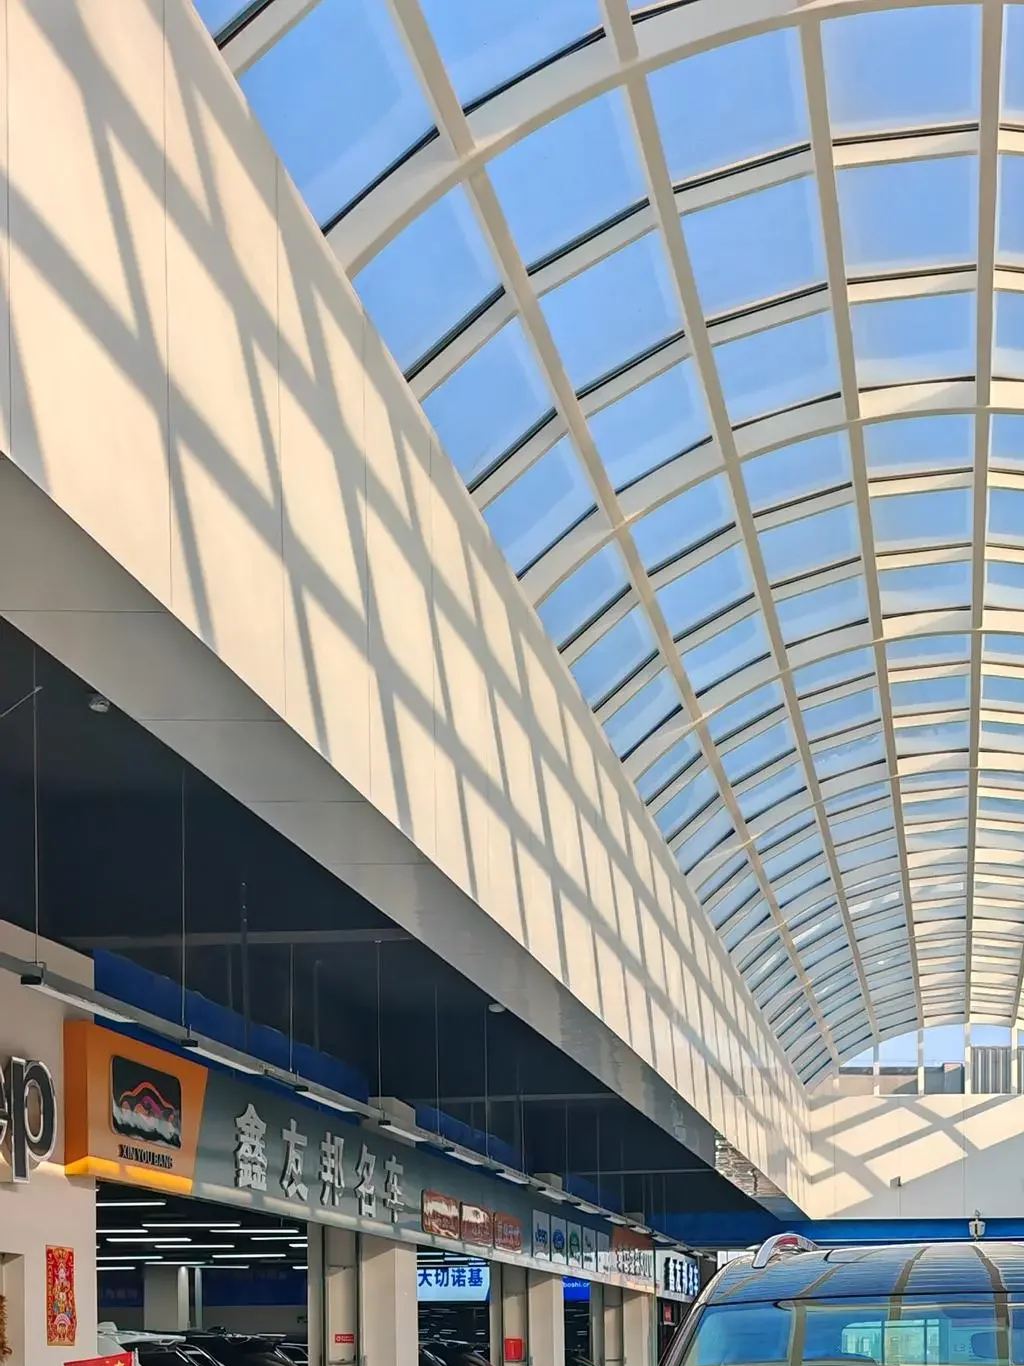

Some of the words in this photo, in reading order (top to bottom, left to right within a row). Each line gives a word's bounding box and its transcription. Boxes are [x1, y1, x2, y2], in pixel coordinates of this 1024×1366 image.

[0, 1056, 57, 1183] p
[234, 1103, 405, 1223] 鑫友邦名车
[418, 1268, 483, 1288] 大切诺基
